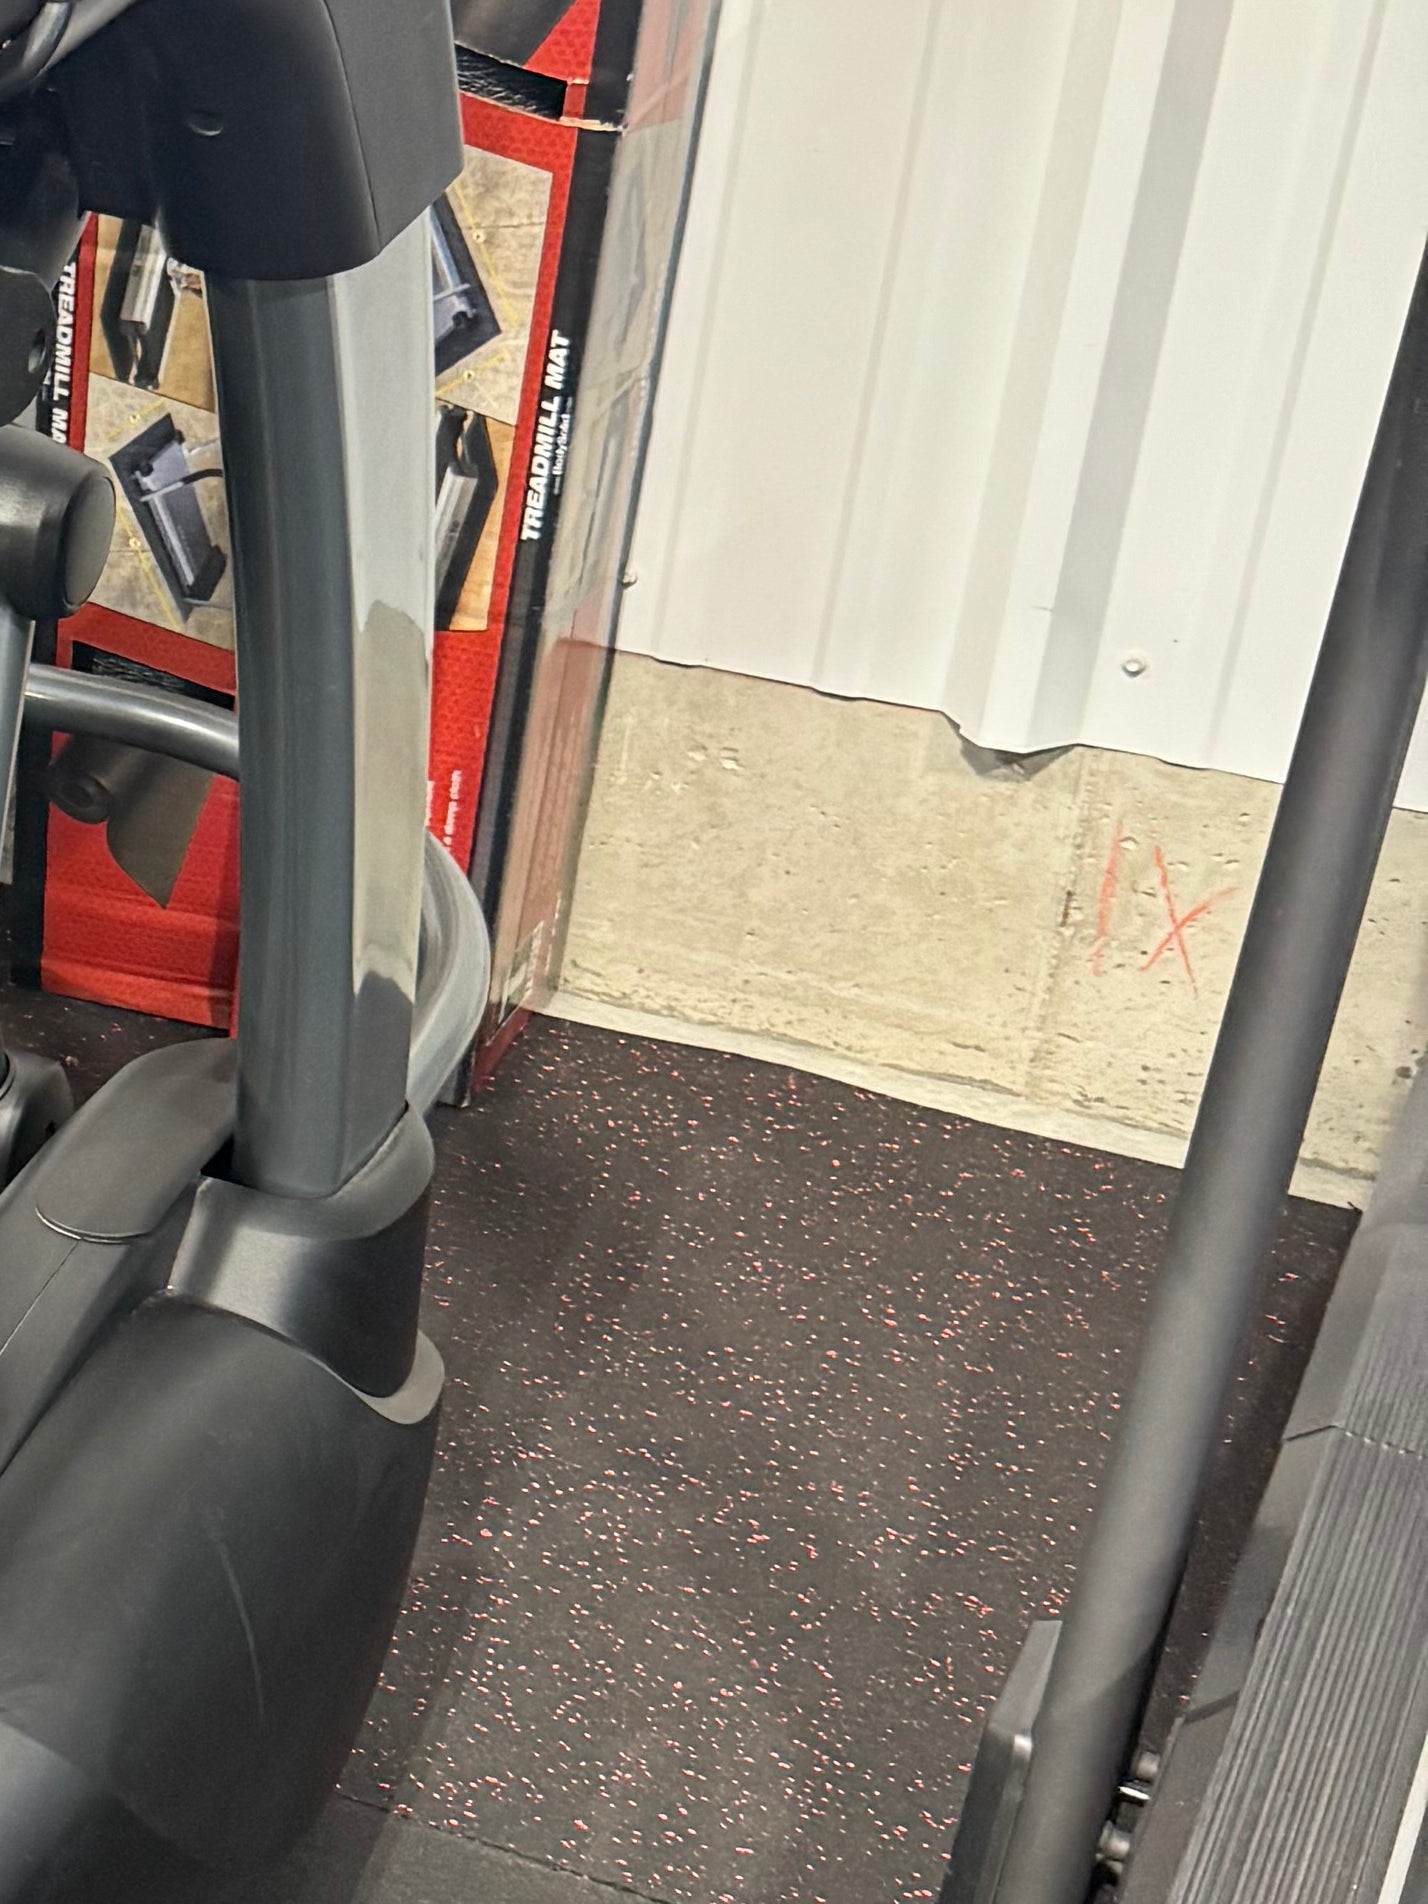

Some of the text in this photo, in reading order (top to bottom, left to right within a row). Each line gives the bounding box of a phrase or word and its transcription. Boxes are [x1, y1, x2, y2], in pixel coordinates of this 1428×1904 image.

[51, 261, 77, 445] TREADMILL MA
[521, 329, 572, 541] TREADMILL MAT
